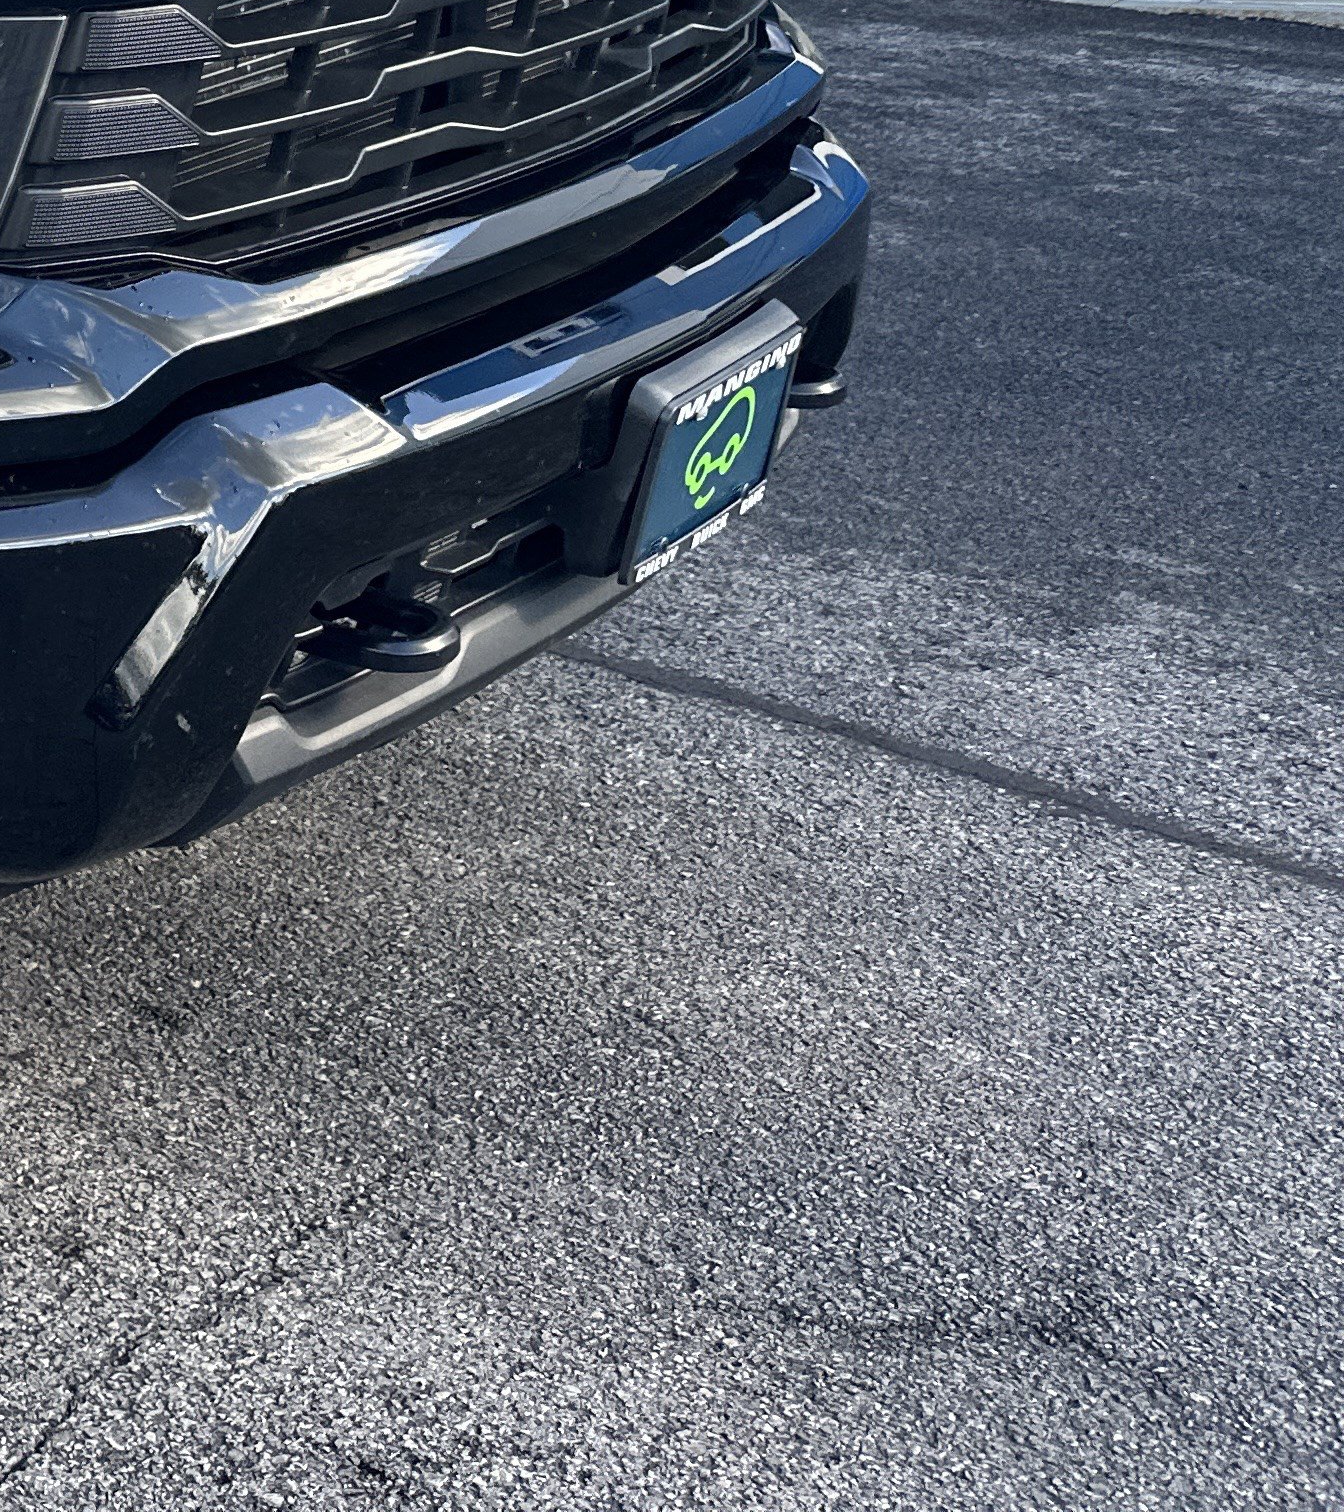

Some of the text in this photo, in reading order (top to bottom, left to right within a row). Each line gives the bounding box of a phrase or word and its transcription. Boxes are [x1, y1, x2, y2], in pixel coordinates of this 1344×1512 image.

[675, 332, 803, 426] MANGINO
[635, 486, 766, 583] CHEVY BUICK GMC
